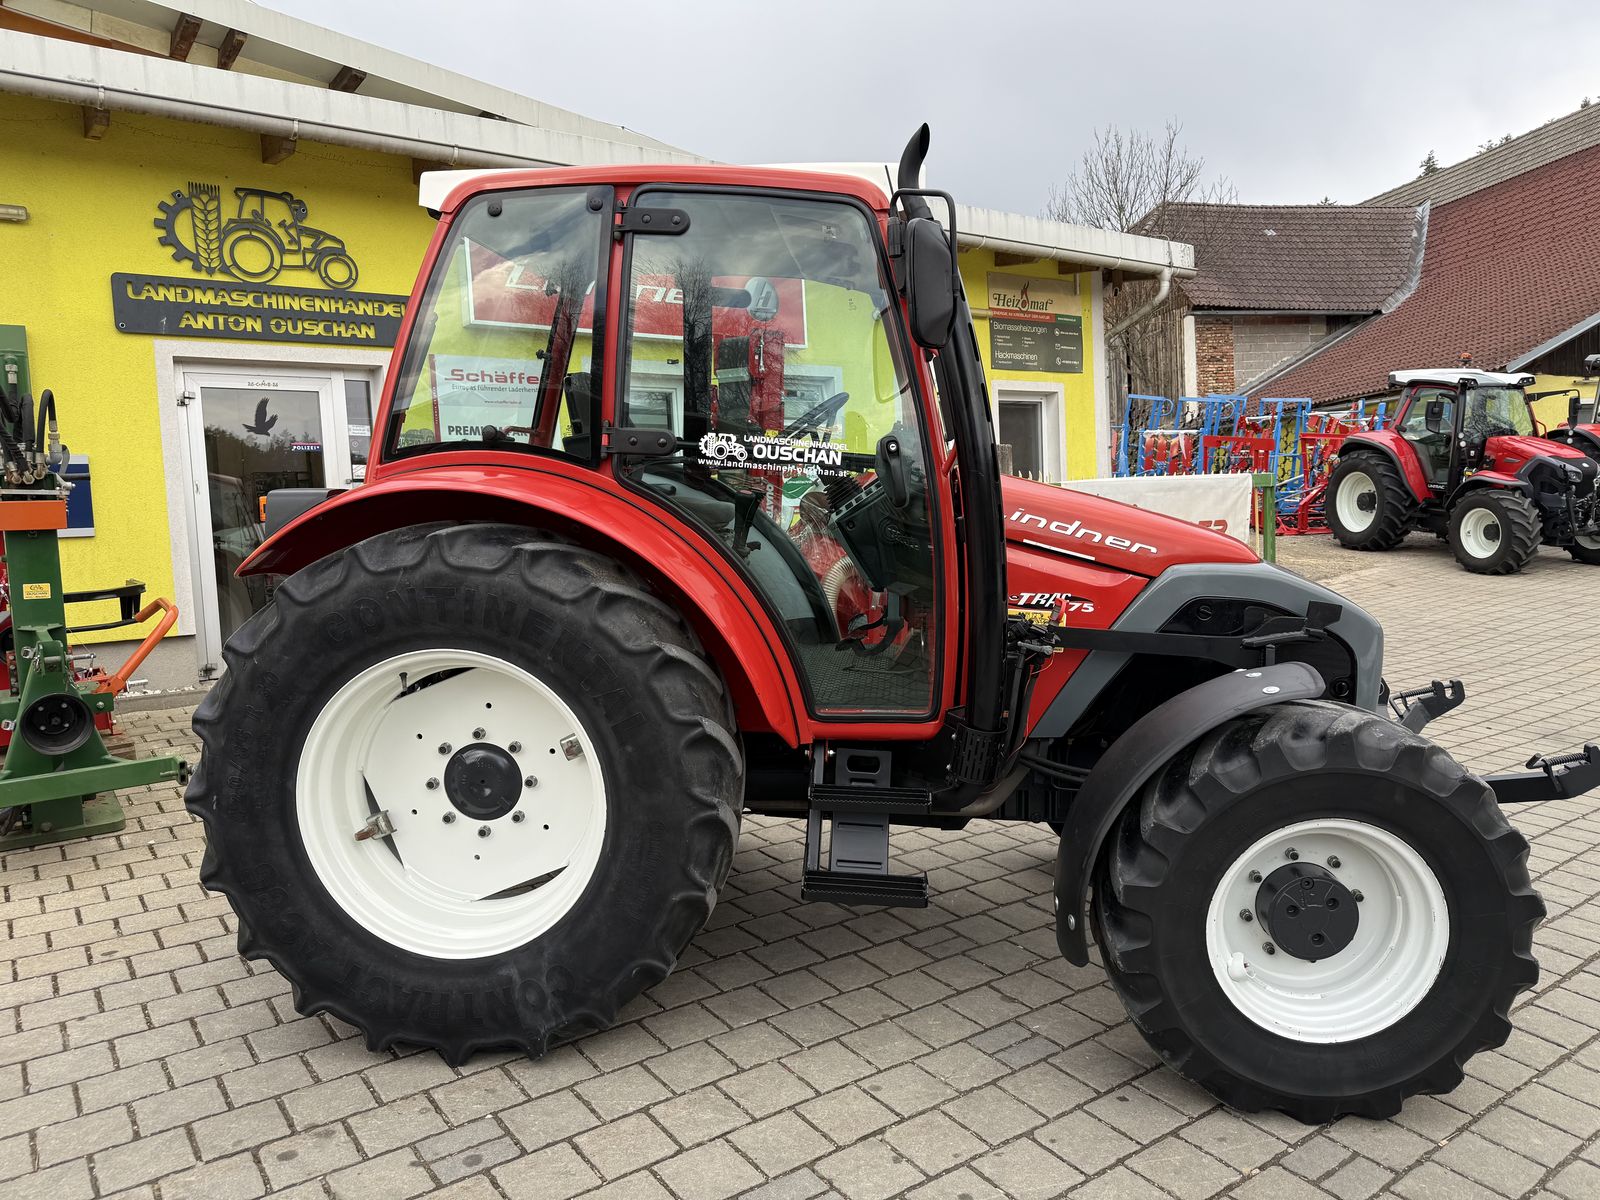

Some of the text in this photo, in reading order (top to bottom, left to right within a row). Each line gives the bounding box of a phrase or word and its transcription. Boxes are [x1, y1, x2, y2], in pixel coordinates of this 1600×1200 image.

[178, 311, 376, 340] ANTON OUSCHAN
[993, 321, 1048, 335] Biomasseheizungen
[994, 350, 1038, 360] Hackmaschinen
[444, 368, 539, 385] Schäffe
[743, 434, 849, 451] LANDMASCHINENHANDEL
[753, 443, 842, 466] OUSCHAN
[1003, 508, 1158, 554] indner
[1068, 602, 1095, 613] 75
